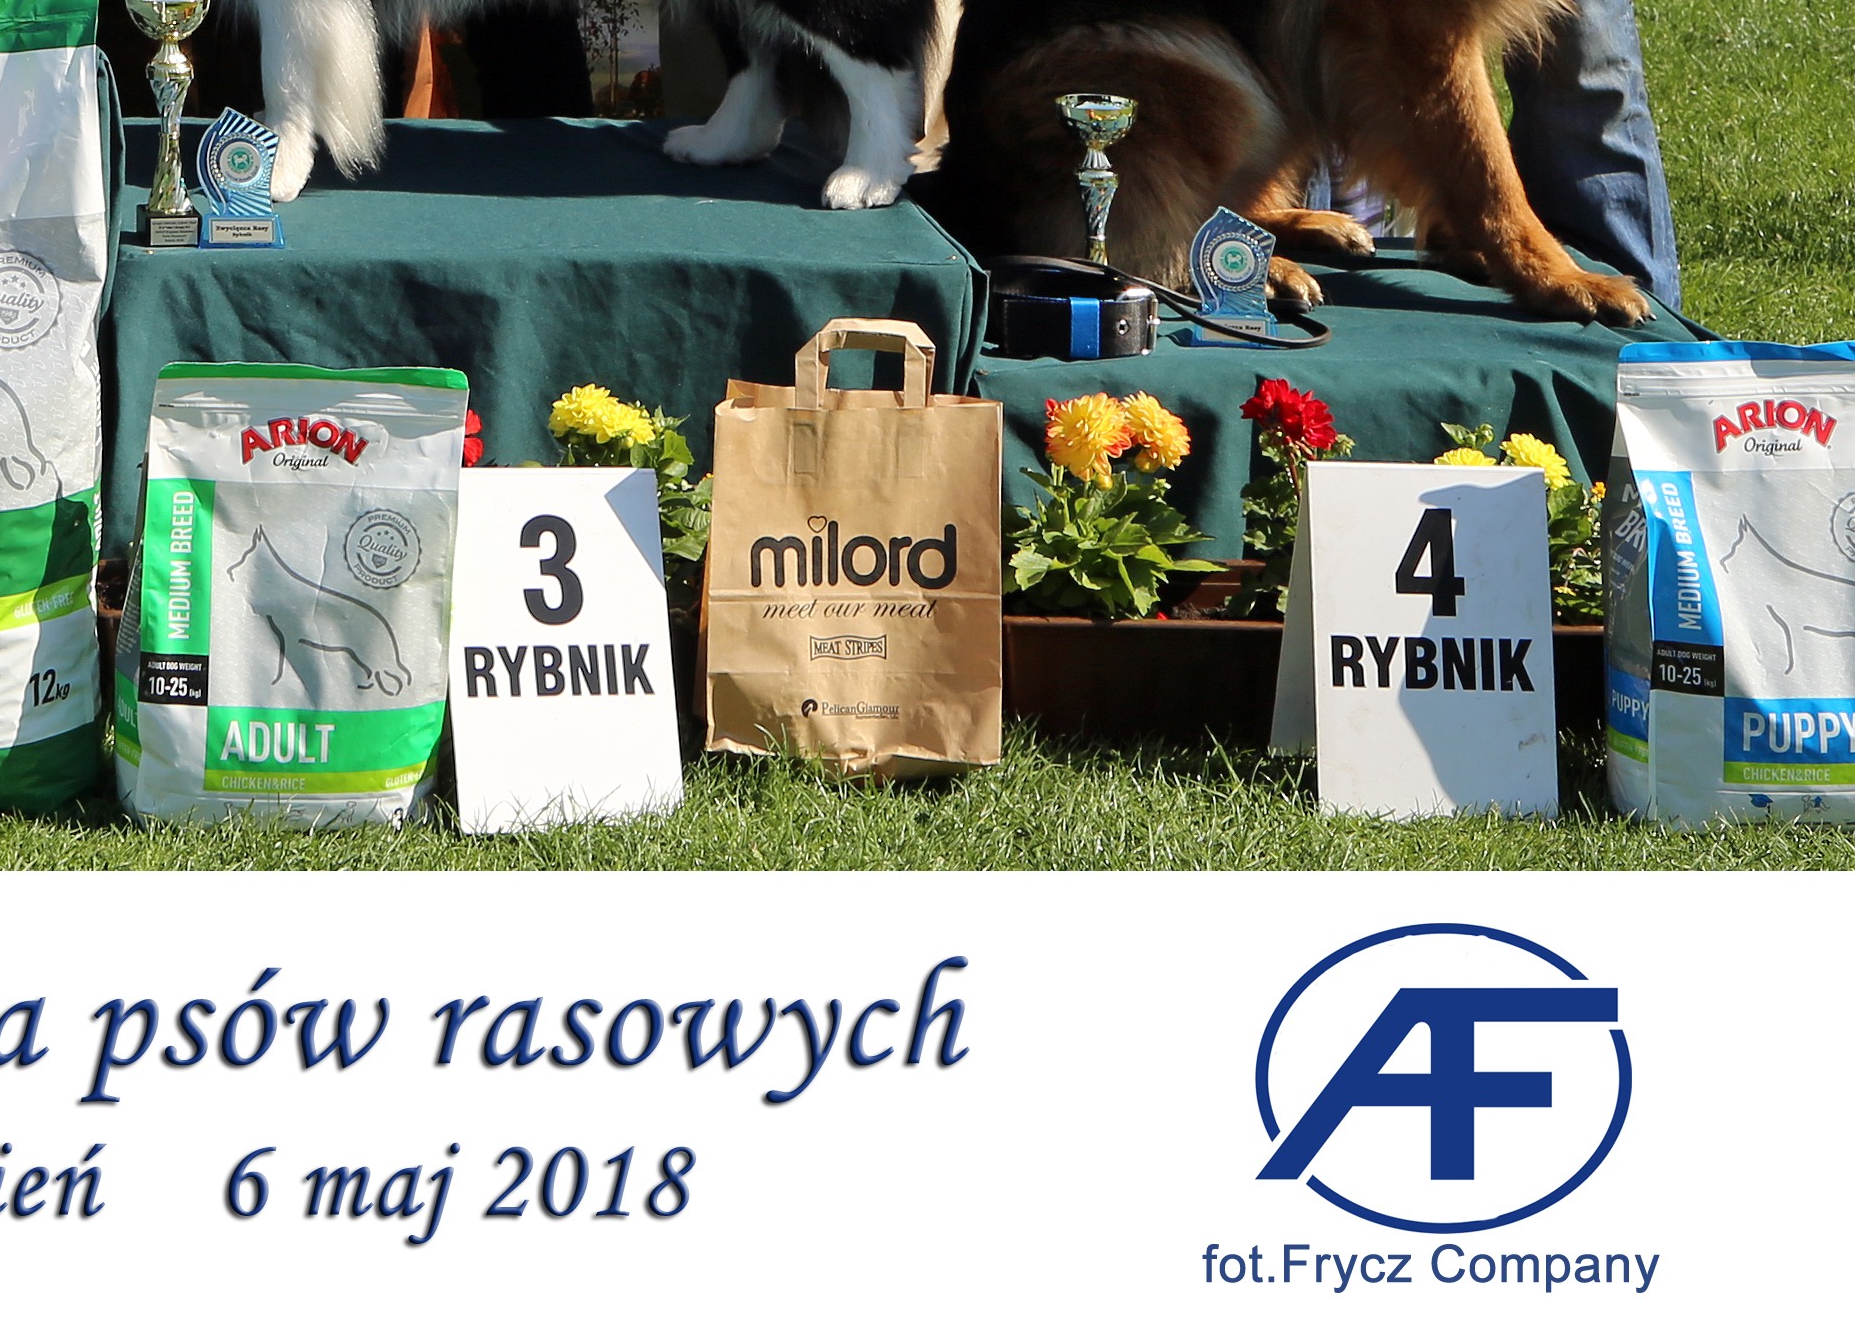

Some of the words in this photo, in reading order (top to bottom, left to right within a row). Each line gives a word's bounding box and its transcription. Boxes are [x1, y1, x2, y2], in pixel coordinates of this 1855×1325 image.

[241, 417, 371, 466] ARION
[1712, 398, 1838, 454] ARION
[273, 451, 329, 470] Original
[1744, 437, 1804, 457] Original
[172, 490, 195, 555] BREED
[367, 513, 412, 535] PREMIUM
[1661, 482, 1693, 545] BREED
[357, 534, 408, 562] Quality
[749, 514, 958, 590] milord
[1395, 508, 1466, 618] 4
[354, 563, 399, 585] PRODUCT
[519, 513, 584, 626] 3
[167, 560, 191, 640] MEDIUM
[761, 598, 818, 620] meet
[823, 602, 867, 620] our
[872, 597, 939, 620] meat
[1676, 551, 1703, 631] MEDIUM
[813, 641, 842, 655] MEAT
[845, 639, 884, 656] STRIPES
[1329, 635, 1536, 693] RYBNIK
[1656, 649, 1677, 659] ADULT
[1677, 650, 1691, 659] DOG
[1691, 651, 1717, 662] WEIGHT
[149, 677, 188, 697] 10-25
[463, 642, 655, 698] RYBNIK
[1659, 663, 1702, 686] 10-25
[821, 701, 900, 716] PelicanGlamour
[220, 719, 336, 764] ADULT
[1743, 712, 1855, 754] PUPPY
[221, 776, 306, 791] CHICKEN&RICE
[1743, 767, 1831, 782] CHICKEN&RICE
